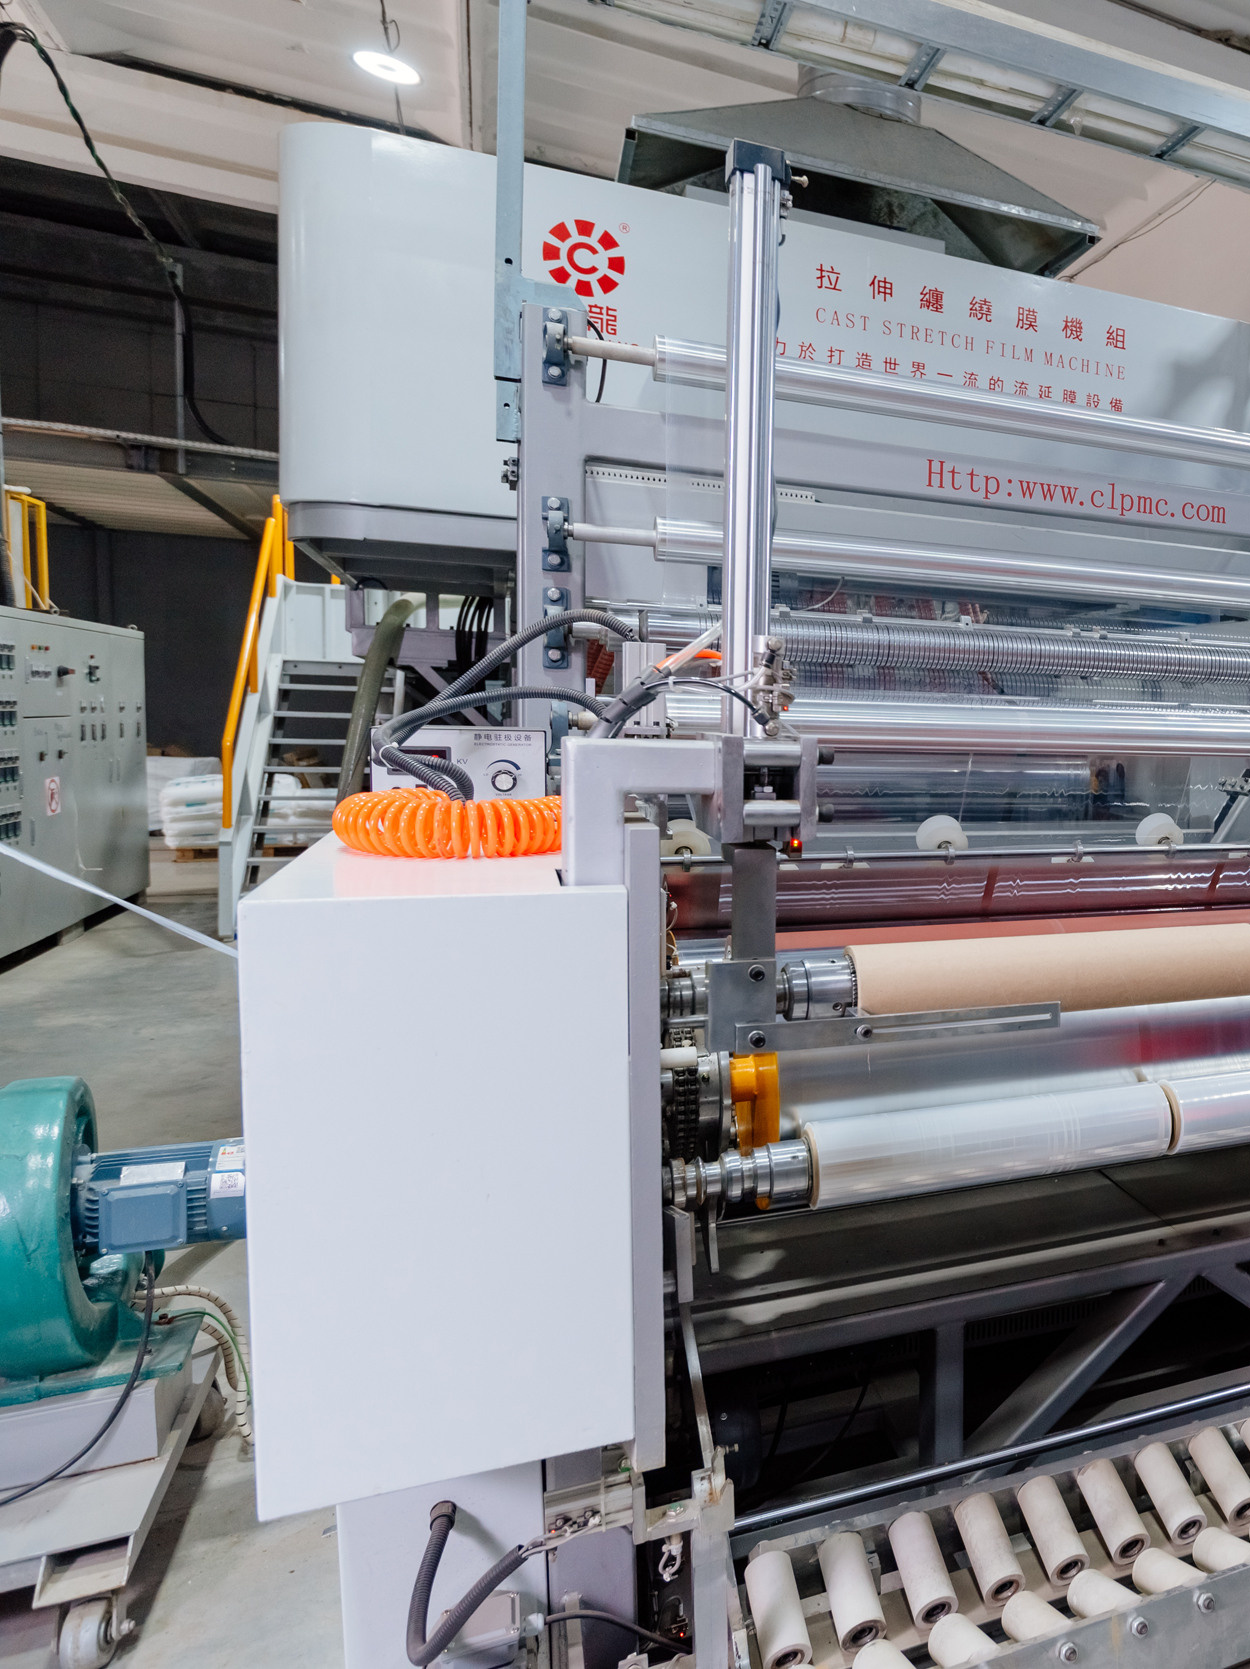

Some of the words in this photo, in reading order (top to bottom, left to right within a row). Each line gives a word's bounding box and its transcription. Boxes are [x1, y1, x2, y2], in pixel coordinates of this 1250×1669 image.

[815, 263, 1127, 351] 拉伸纏繞膜機組
[815, 306, 871, 332] CAST
[882, 319, 975, 352] STRETCH
[985, 339, 1035, 364] FILM
[1043, 350, 1127, 381] MACHINE
[925, 457, 1228, 525] Http:www.clpmc.com
